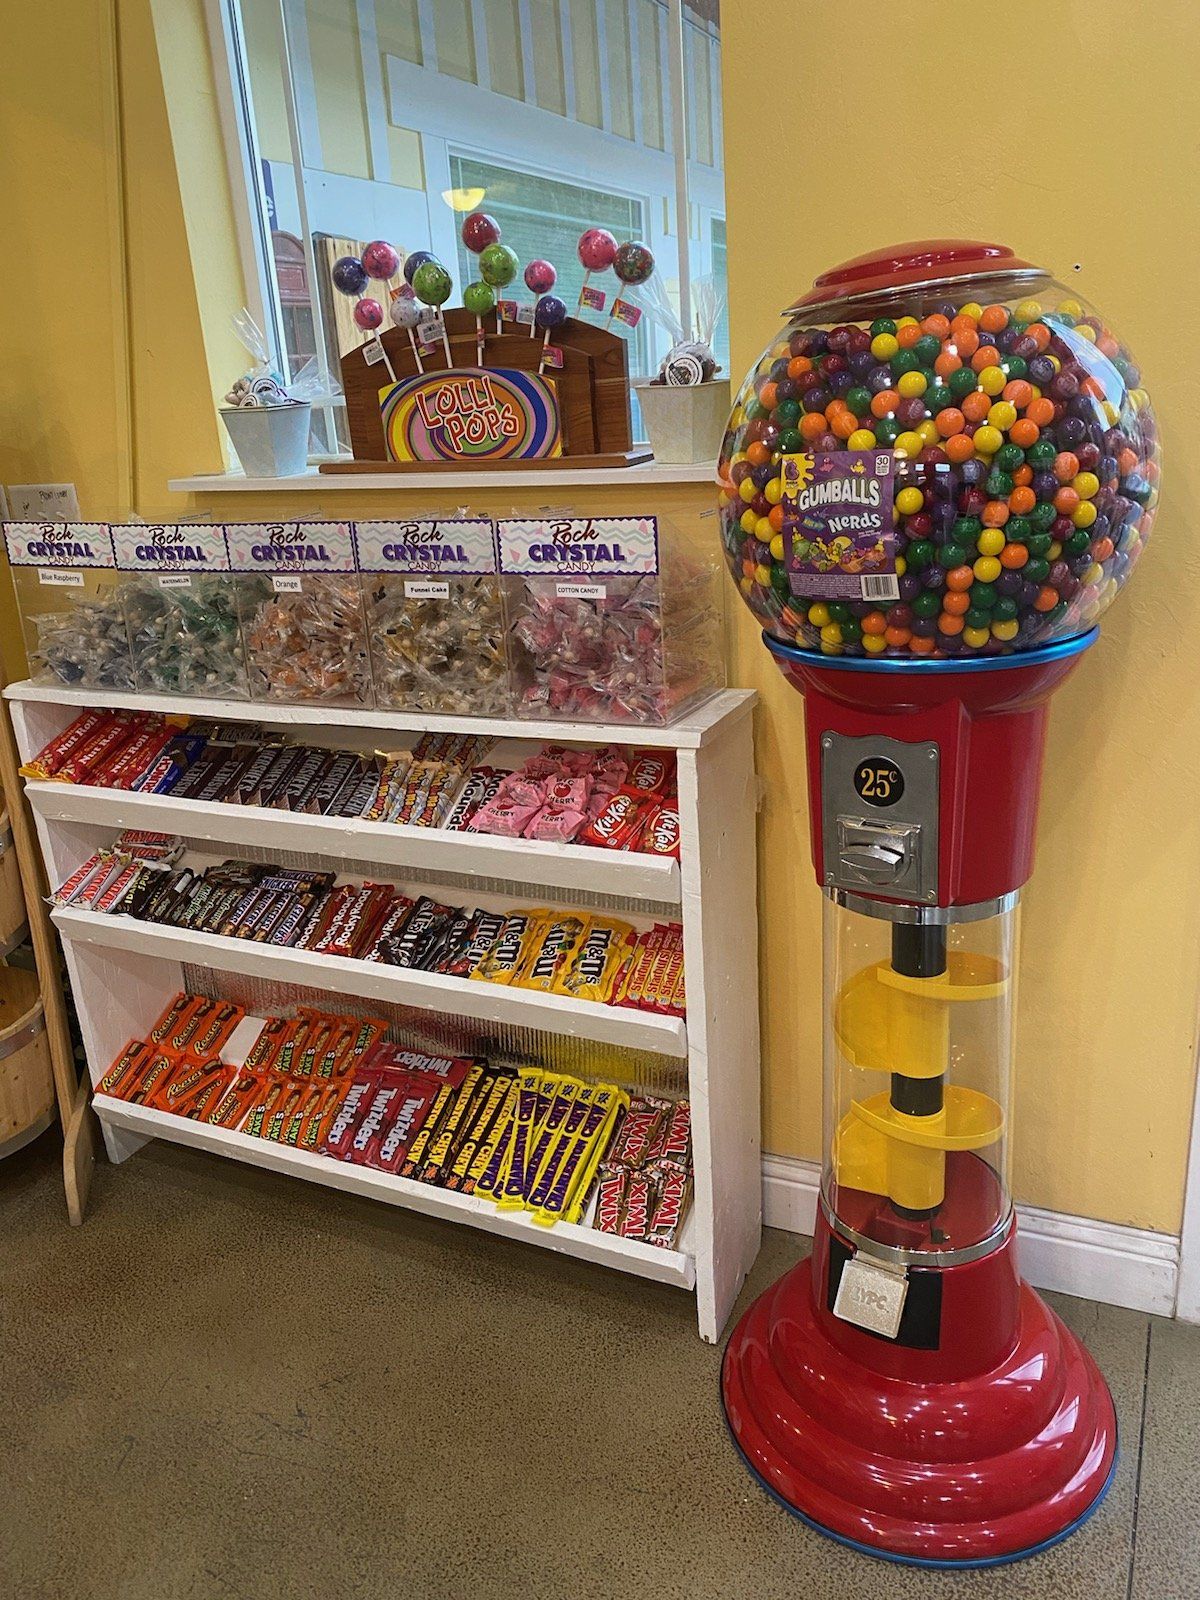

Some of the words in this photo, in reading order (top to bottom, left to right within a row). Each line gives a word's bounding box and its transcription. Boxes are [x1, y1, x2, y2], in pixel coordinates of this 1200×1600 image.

[415, 375, 496, 430] LOLLI
[445, 404, 518, 453] POPS
[876, 457, 888, 465] 30
[799, 478, 881, 511] GUMBALLS
[40, 525, 74, 544] Rock
[149, 527, 186, 547] Rock
[267, 525, 307, 547] Rock
[401, 523, 444, 547] Rock
[550, 520, 600, 547] Rock
[27, 542, 94, 558] CRYSTAL
[48, 557, 74, 565] CANDY
[135, 545, 207, 562] CRYSTAL
[157, 560, 186, 570] CANDY
[251, 545, 329, 562] CRYSTAL
[275, 560, 306, 570] CANDY
[382, 543, 468, 562] CRYSTAL
[528, 543, 625, 562] CRYSTAL
[41, 573, 54, 582] Blue
[55, 574, 81, 584] Raspberry
[407, 560, 443, 571] CANDY
[556, 560, 596, 572] CANDY
[275, 580, 298, 589] Orange
[410, 586, 430, 594] Funnel
[431, 586, 447, 594] Cake
[56, 736, 79, 755] Nut
[76, 716, 98, 736] Roll
[78, 747, 101, 765] Nut
[100, 727, 122, 747] Roll
[110, 756, 128, 774] Nut
[128, 734, 150, 757] Roll
[143, 756, 172, 793] RUNCH
[169, 761, 209, 796] ERSHEY'S
[287, 753, 326, 796] HERSHEY'S
[316, 757, 352, 800] HERSHEY'S
[547, 794, 576, 804] CHERRY
[334, 888, 372, 946] RockyRoad
[580, 929, 613, 984] m&m's
[303, 1054, 314, 1076] AKE
[322, 1057, 335, 1078] AKE
[424, 1082, 453, 1128] RLESTON
[445, 1065, 484, 1131] CHARLESTON
[469, 1075, 511, 1141] CHARLESTON
[270, 1118, 283, 1140] AKE
[661, 1105, 690, 1157] TWIX
[406, 1130, 430, 1164] CHEW
[428, 1131, 453, 1167] CHEW
[452, 1142, 476, 1177] CHEW
[468, 1145, 491, 1179] CHEW
[600, 1173, 624, 1233] TWIX
[620, 1183, 648, 1236] TWIX
[650, 1172, 685, 1231] TWIX
